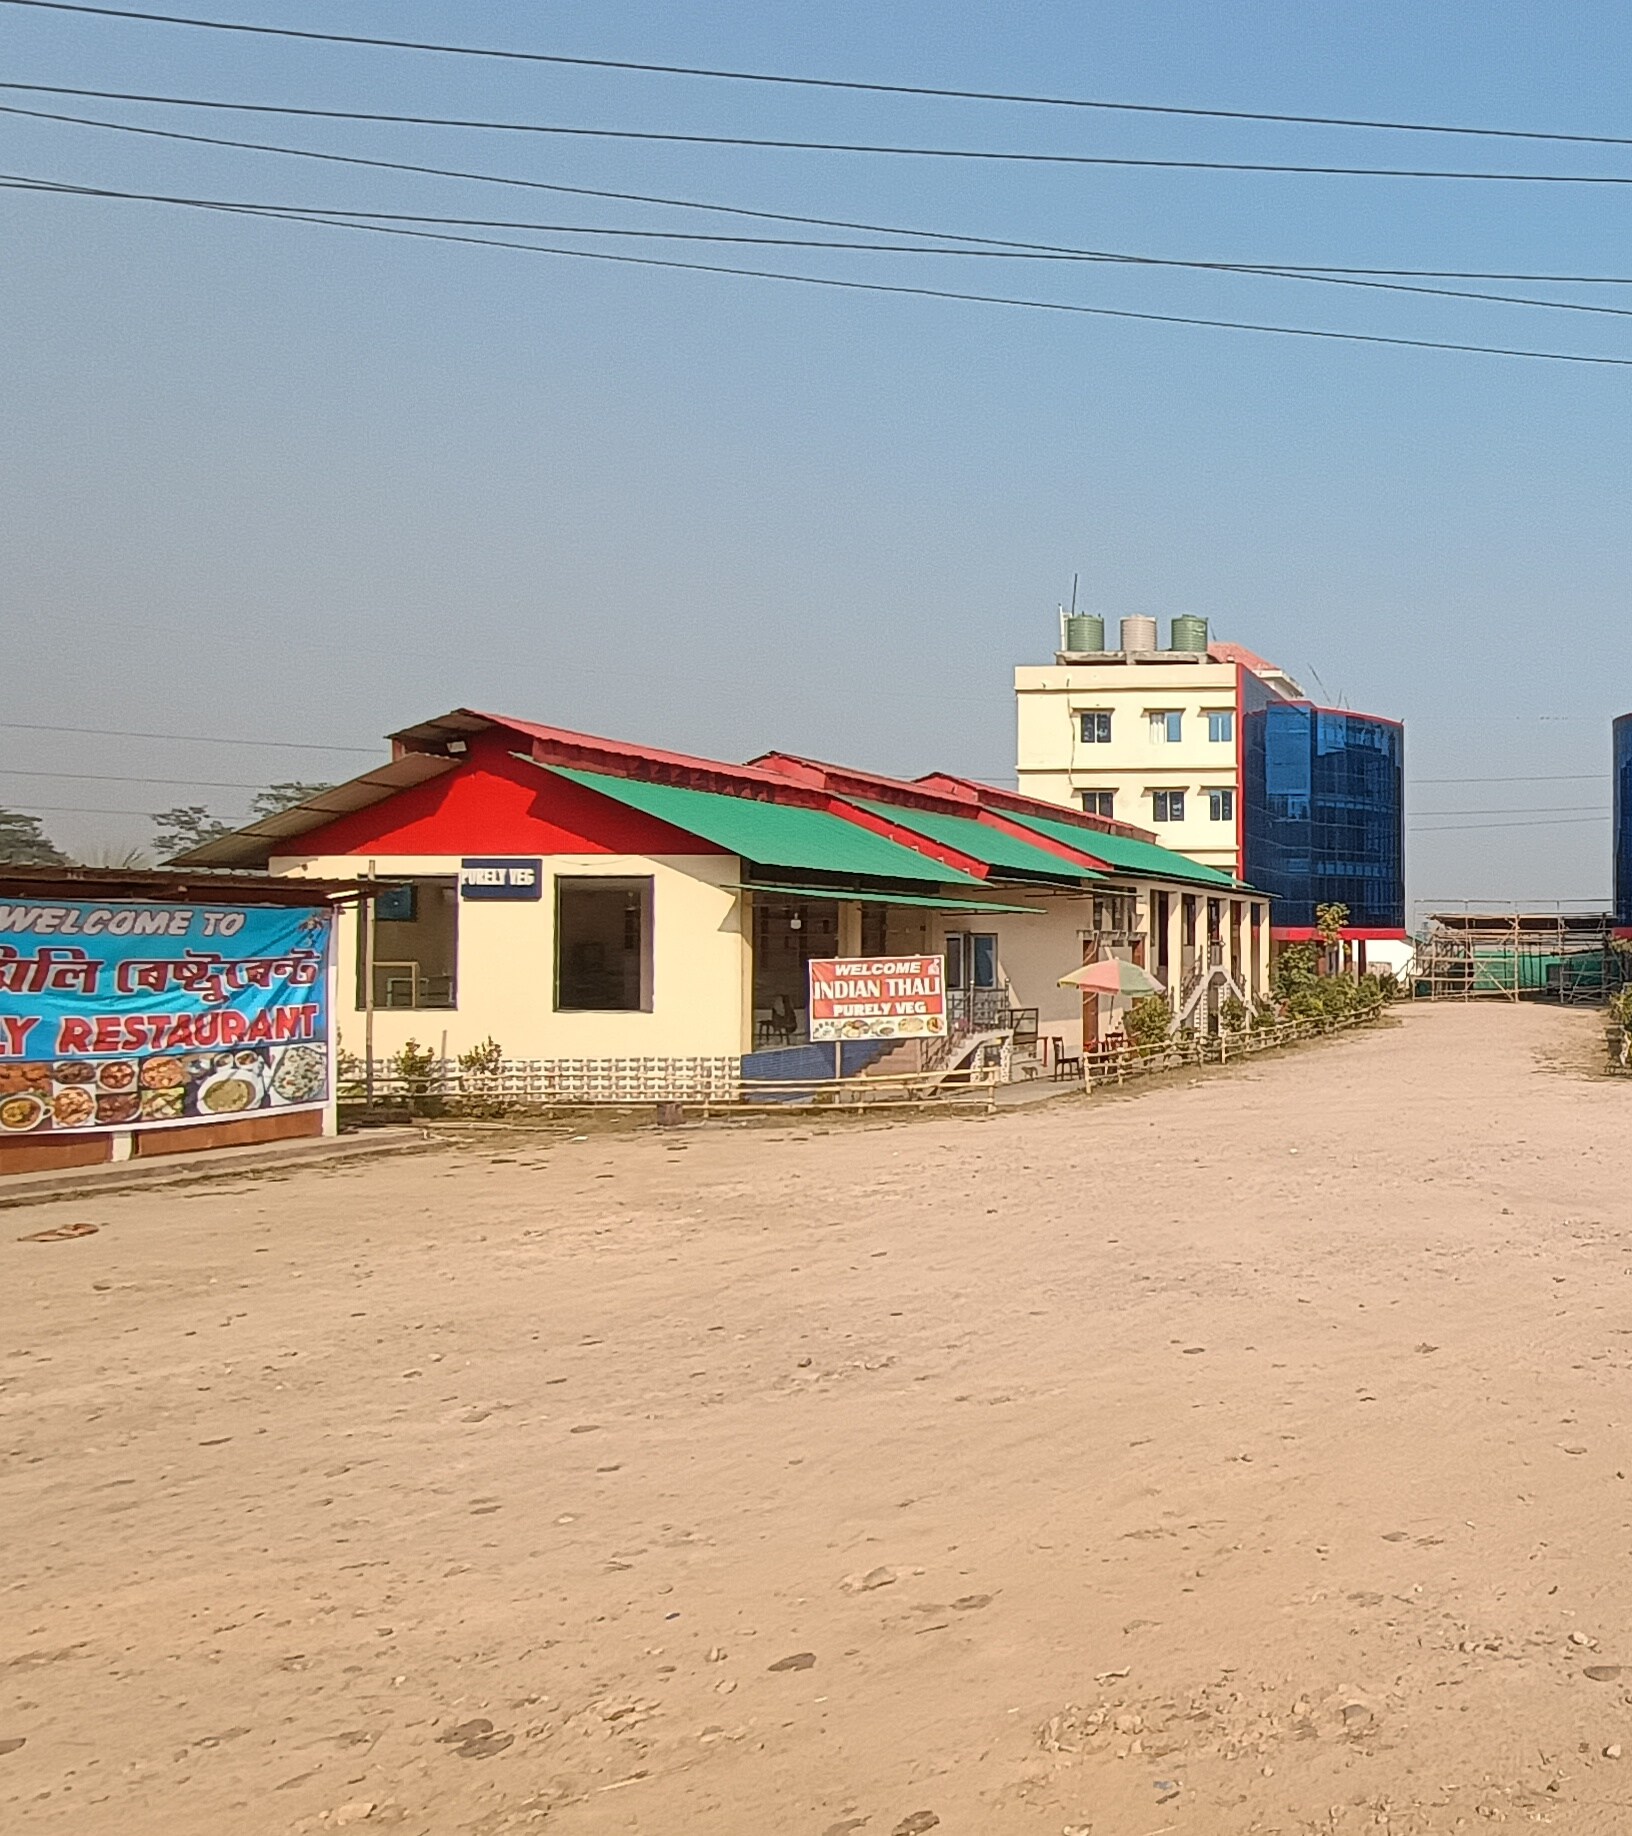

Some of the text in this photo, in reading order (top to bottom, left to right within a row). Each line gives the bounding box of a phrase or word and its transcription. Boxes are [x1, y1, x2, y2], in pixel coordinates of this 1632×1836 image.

[461, 868, 535, 886] PURELY VEG
[0, 905, 246, 937] WELCOME TO
[835, 962, 922, 976] WELCOME
[814, 977, 940, 999] INDIAN THALI
[833, 1001, 926, 1017] PURELY VEG
[0, 1005, 319, 1056] Y RESTAURANT
